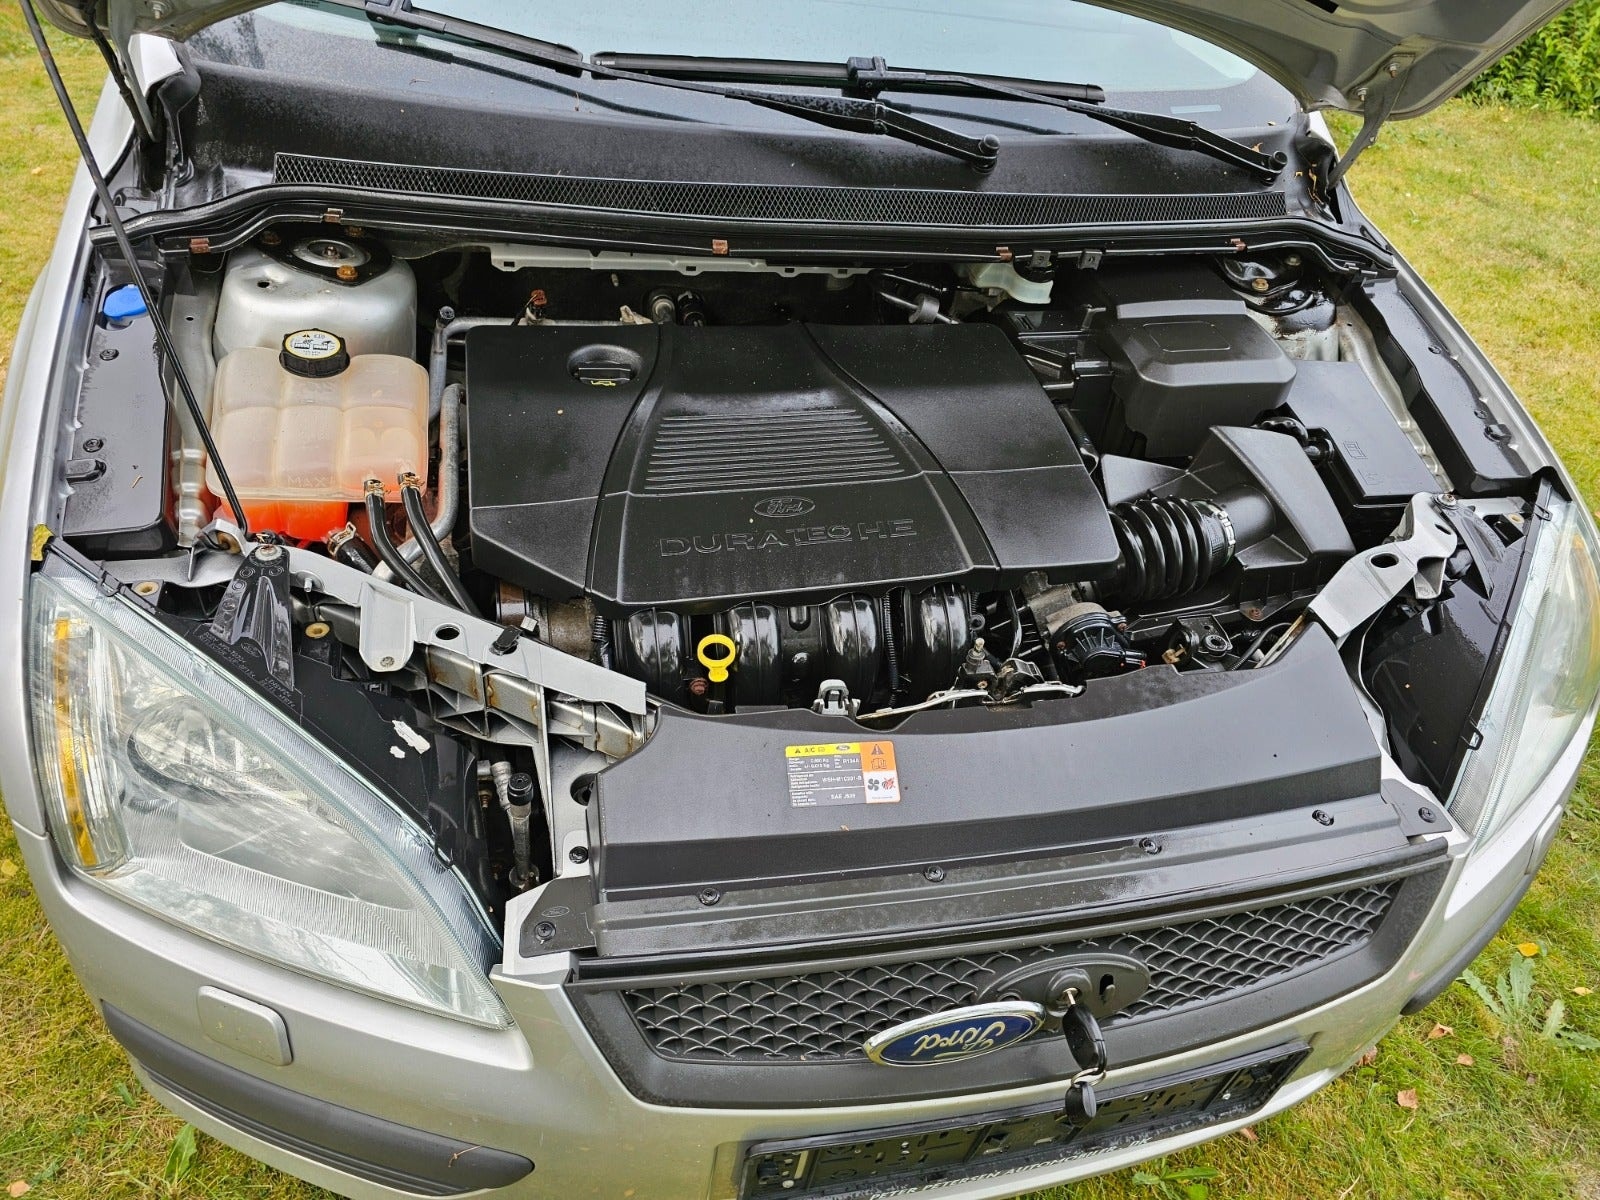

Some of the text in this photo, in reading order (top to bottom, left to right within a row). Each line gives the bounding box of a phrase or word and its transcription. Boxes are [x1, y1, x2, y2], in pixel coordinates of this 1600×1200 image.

[287, 477, 327, 488] MAX
[659, 518, 917, 557] DURATEC HE
[911, 1021, 1006, 1057] Ford
[869, 1187, 918, 1200] PETER
[922, 1170, 1001, 1191] PETERSEN
